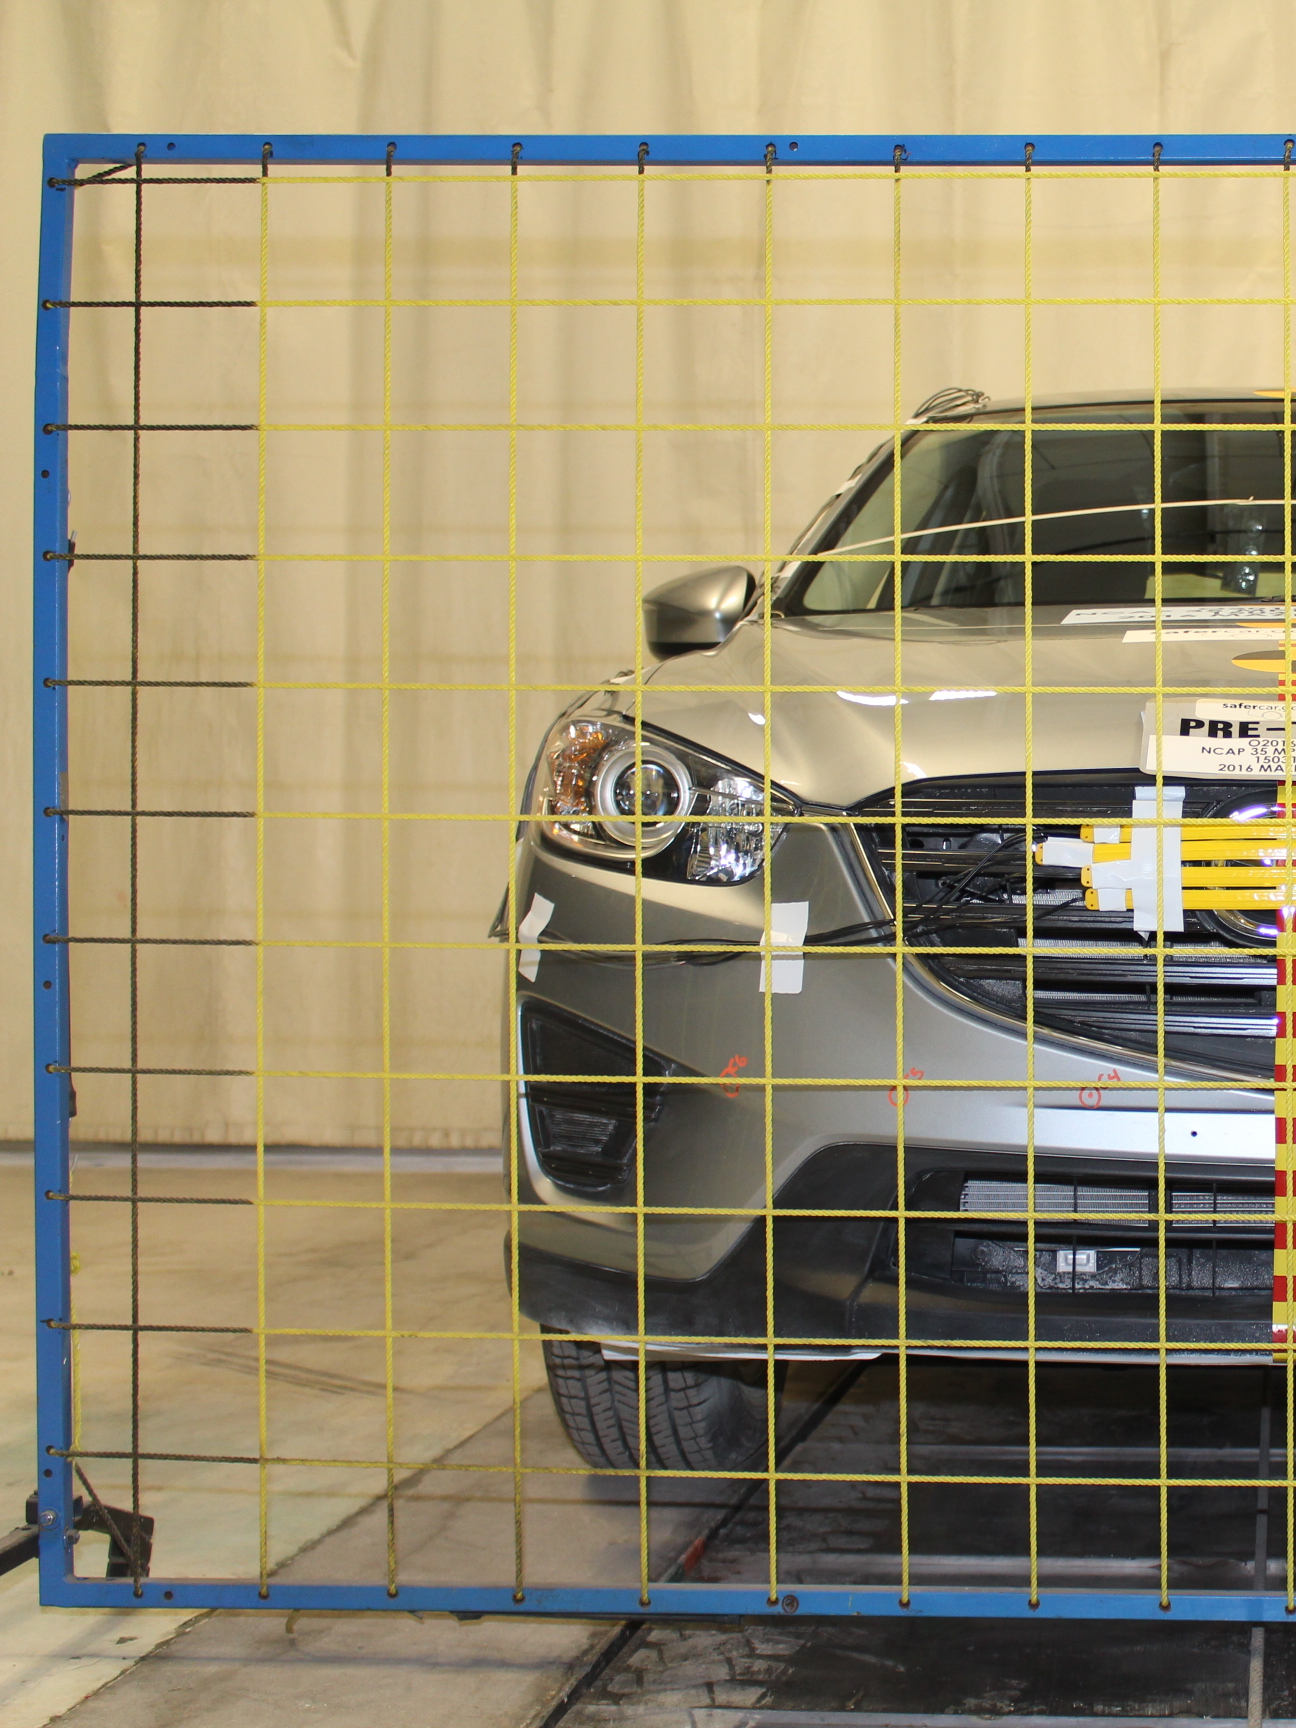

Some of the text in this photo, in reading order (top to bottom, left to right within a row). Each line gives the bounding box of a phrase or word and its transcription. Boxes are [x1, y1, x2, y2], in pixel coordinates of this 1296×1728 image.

[1201, 746, 1245, 755] NCAP
[1250, 748, 1268, 756] 35
[1218, 764, 1254, 772] 2016
